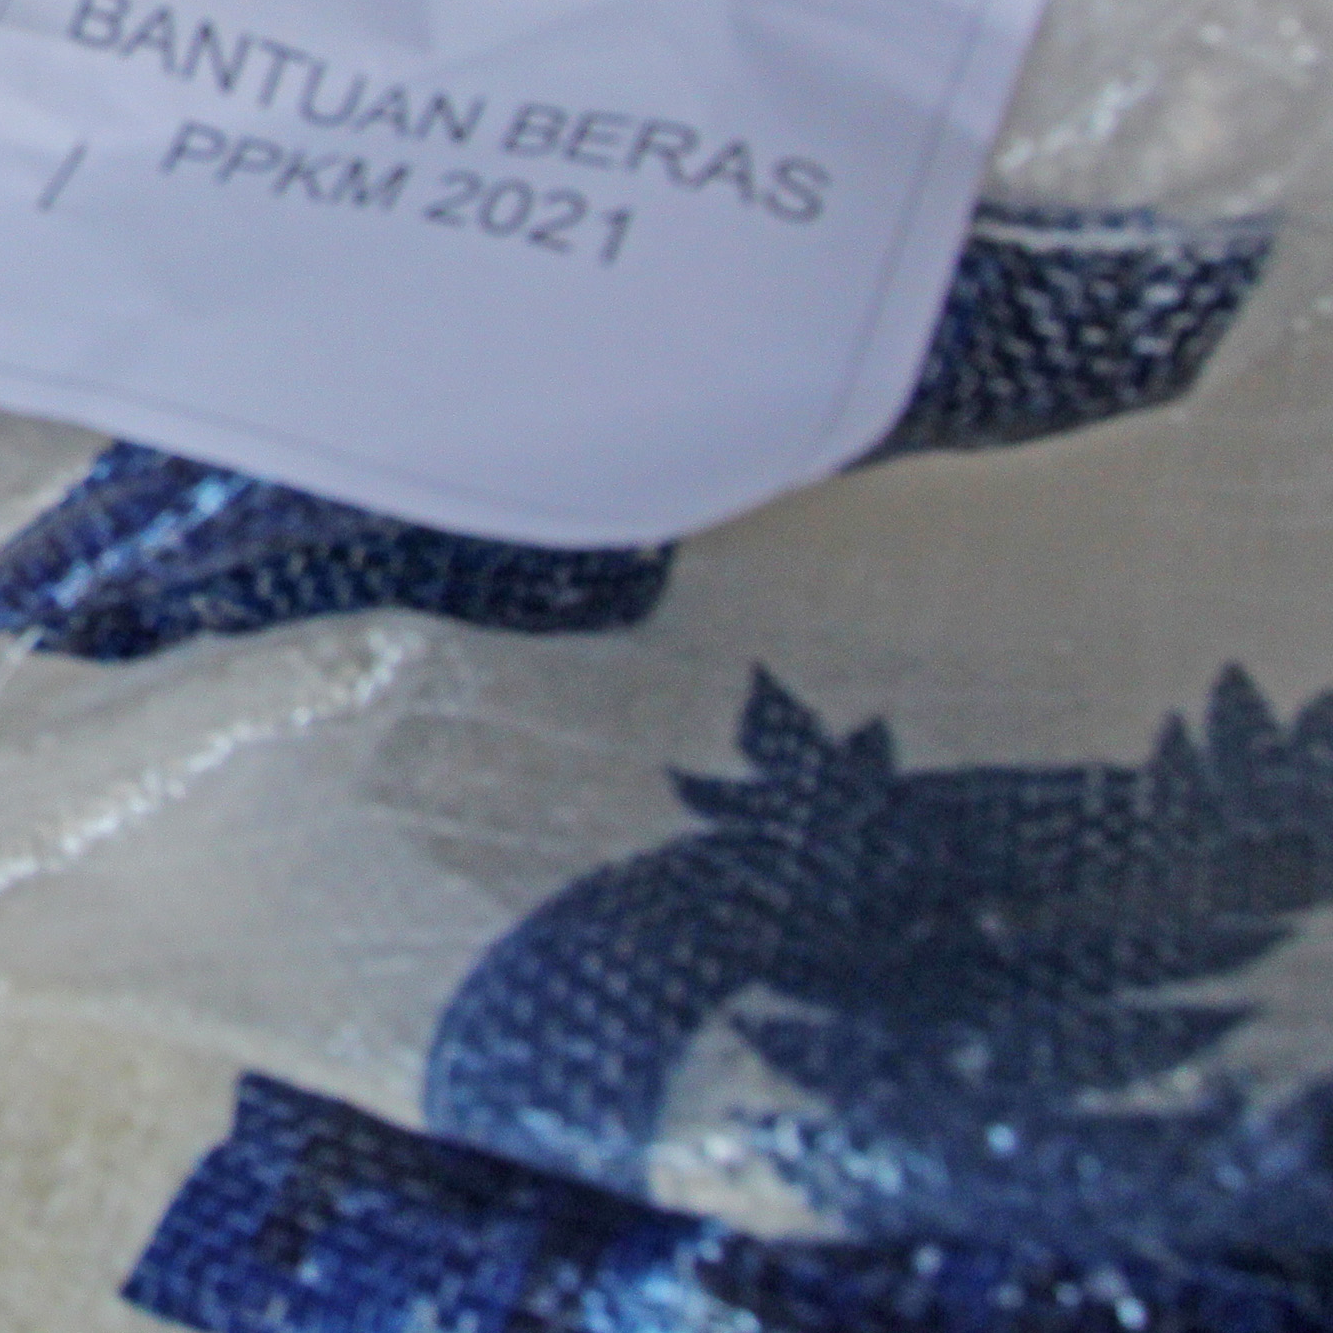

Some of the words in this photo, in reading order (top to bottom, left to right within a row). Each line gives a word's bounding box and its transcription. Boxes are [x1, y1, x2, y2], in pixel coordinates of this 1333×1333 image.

[158, 123, 410, 216] PPKM
[423, 167, 637, 268] 2021
[499, 101, 833, 227] BERAS
